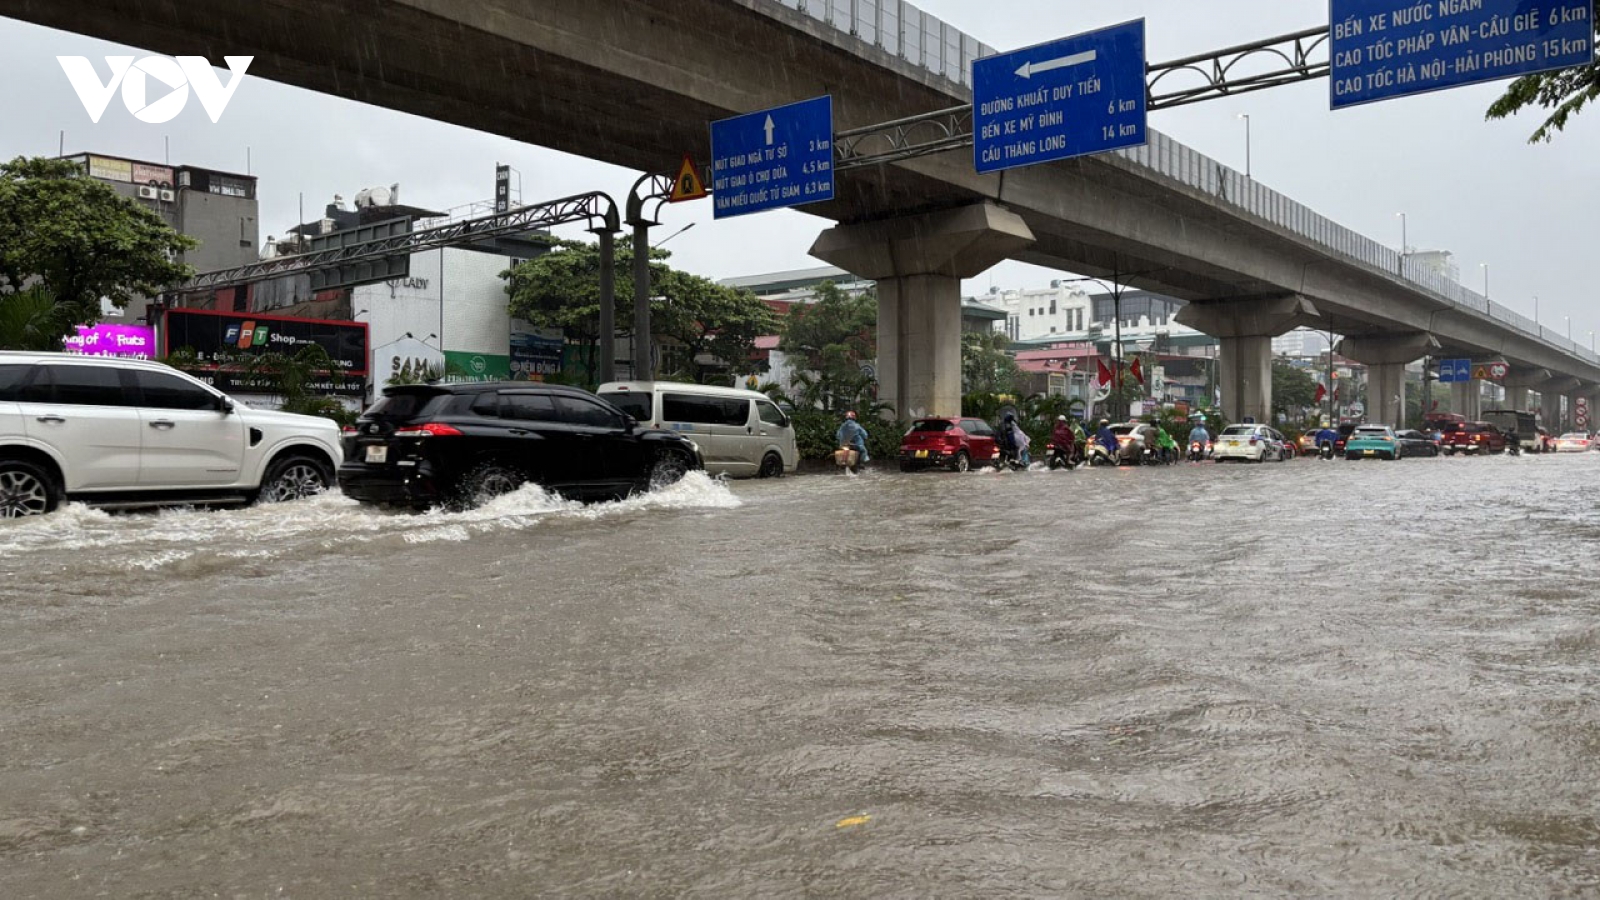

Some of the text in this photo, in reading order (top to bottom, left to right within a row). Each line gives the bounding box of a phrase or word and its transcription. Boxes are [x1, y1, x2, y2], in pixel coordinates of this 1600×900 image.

[1335, 14, 1362, 40] BẾN
[1368, 14, 1387, 32] XE
[1392, 1, 1433, 26] NƯỚC
[1335, 48, 1361, 67] CAO
[1366, 37, 1393, 61] TỐC
[1397, 30, 1435, 55] PHÁP
[1549, 8, 1558, 25] 6
[1561, 6, 1586, 23] km
[1335, 76, 1362, 95] CAO
[1366, 66, 1394, 89] TỐC
[1397, 62, 1416, 84] HÀ
[1484, 43, 1536, 68] PHÒNG
[1542, 40, 1559, 58] 15
[1561, 38, 1586, 55] km
[980, 74, 1101, 116] ĐƯỜNG KHUẤT DUY TIẾN
[982, 99, 1136, 140] BẾN XE MỸ ĐÌNH 6 km
[730, 154, 746, 168] GIAO
[809, 140, 815, 151] 3
[817, 139, 829, 150] km
[1004, 141, 1035, 159] THĂNG
[1040, 134, 1066, 152] LONG
[1102, 125, 1115, 141] 14
[1119, 124, 1136, 137] km
[730, 174, 746, 187] GIAO
[817, 160, 830, 171] km
[818, 181, 830, 192] km
[404, 277, 429, 289] LADY
[86, 332, 99, 345] of
